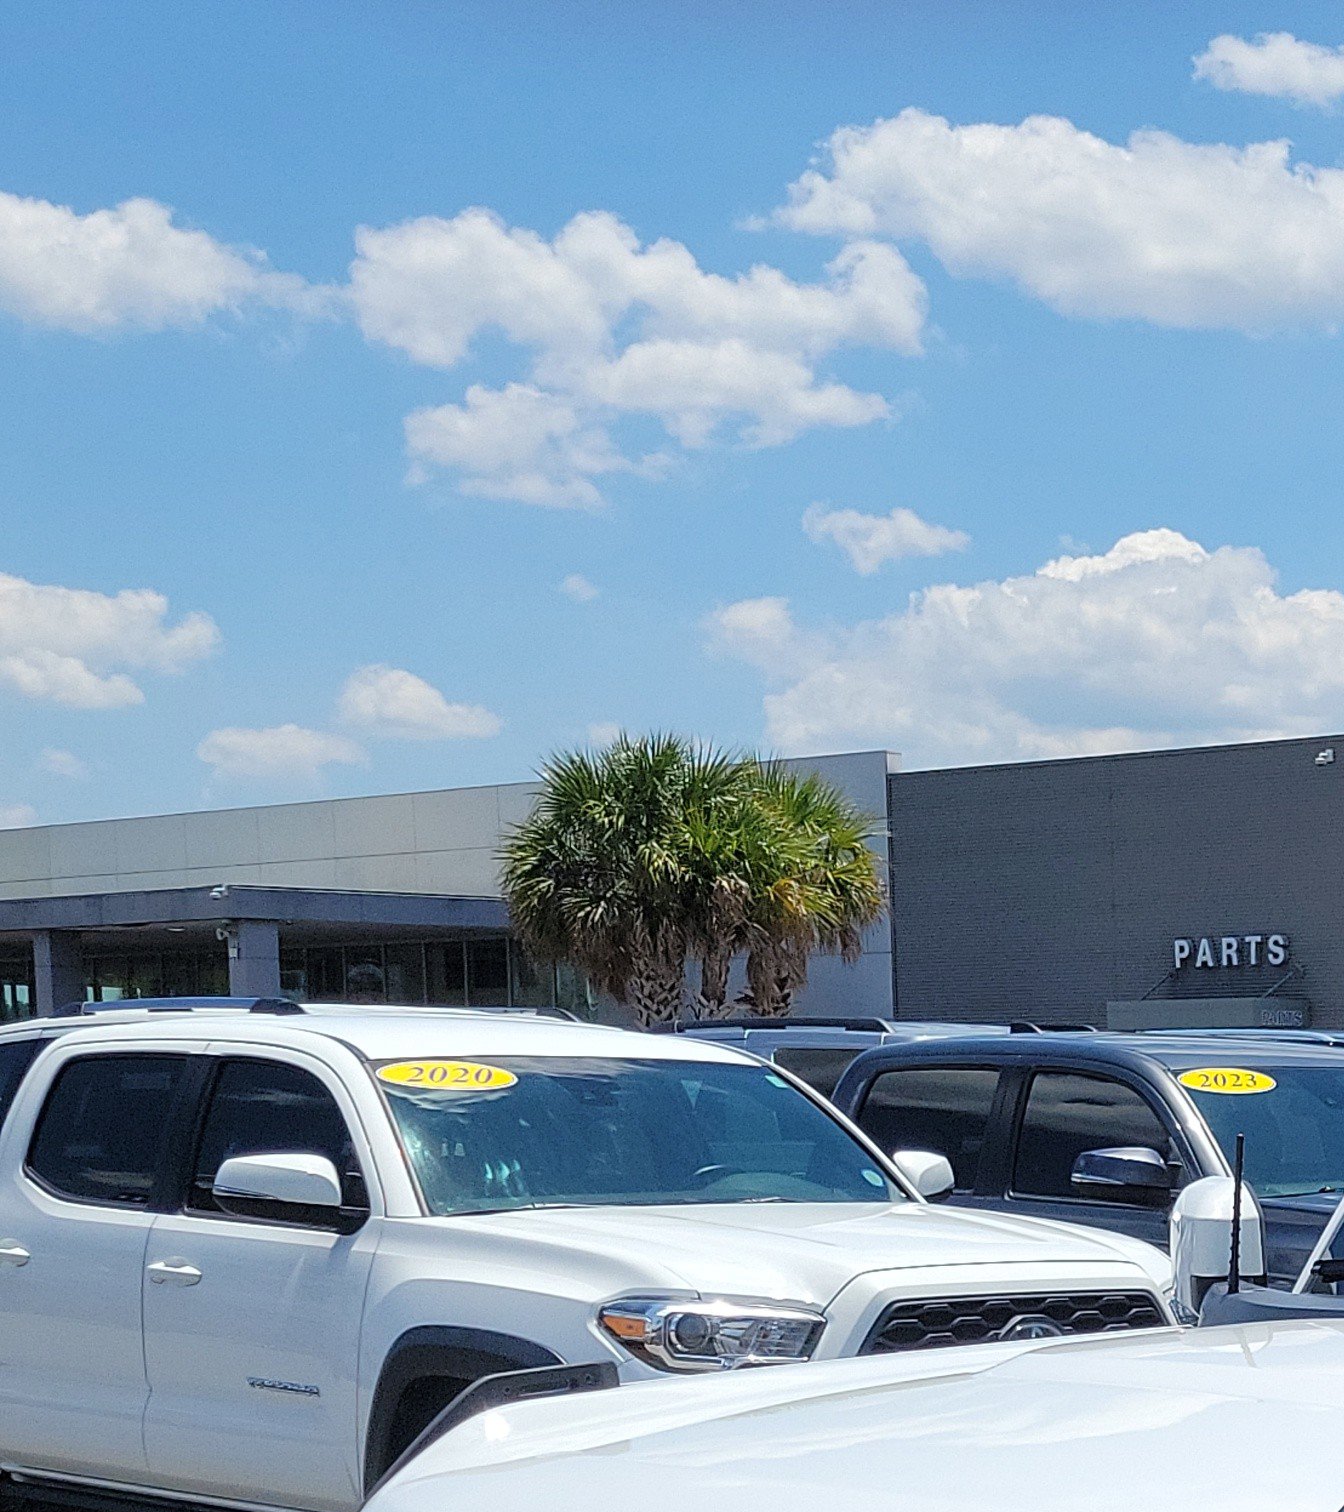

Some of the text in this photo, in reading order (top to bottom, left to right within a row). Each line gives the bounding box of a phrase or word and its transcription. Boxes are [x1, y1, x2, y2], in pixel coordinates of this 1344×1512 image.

[1173, 934, 1286, 969] PARTS
[405, 1066, 493, 1084] 2020
[1198, 1073, 1257, 1088] 2023
